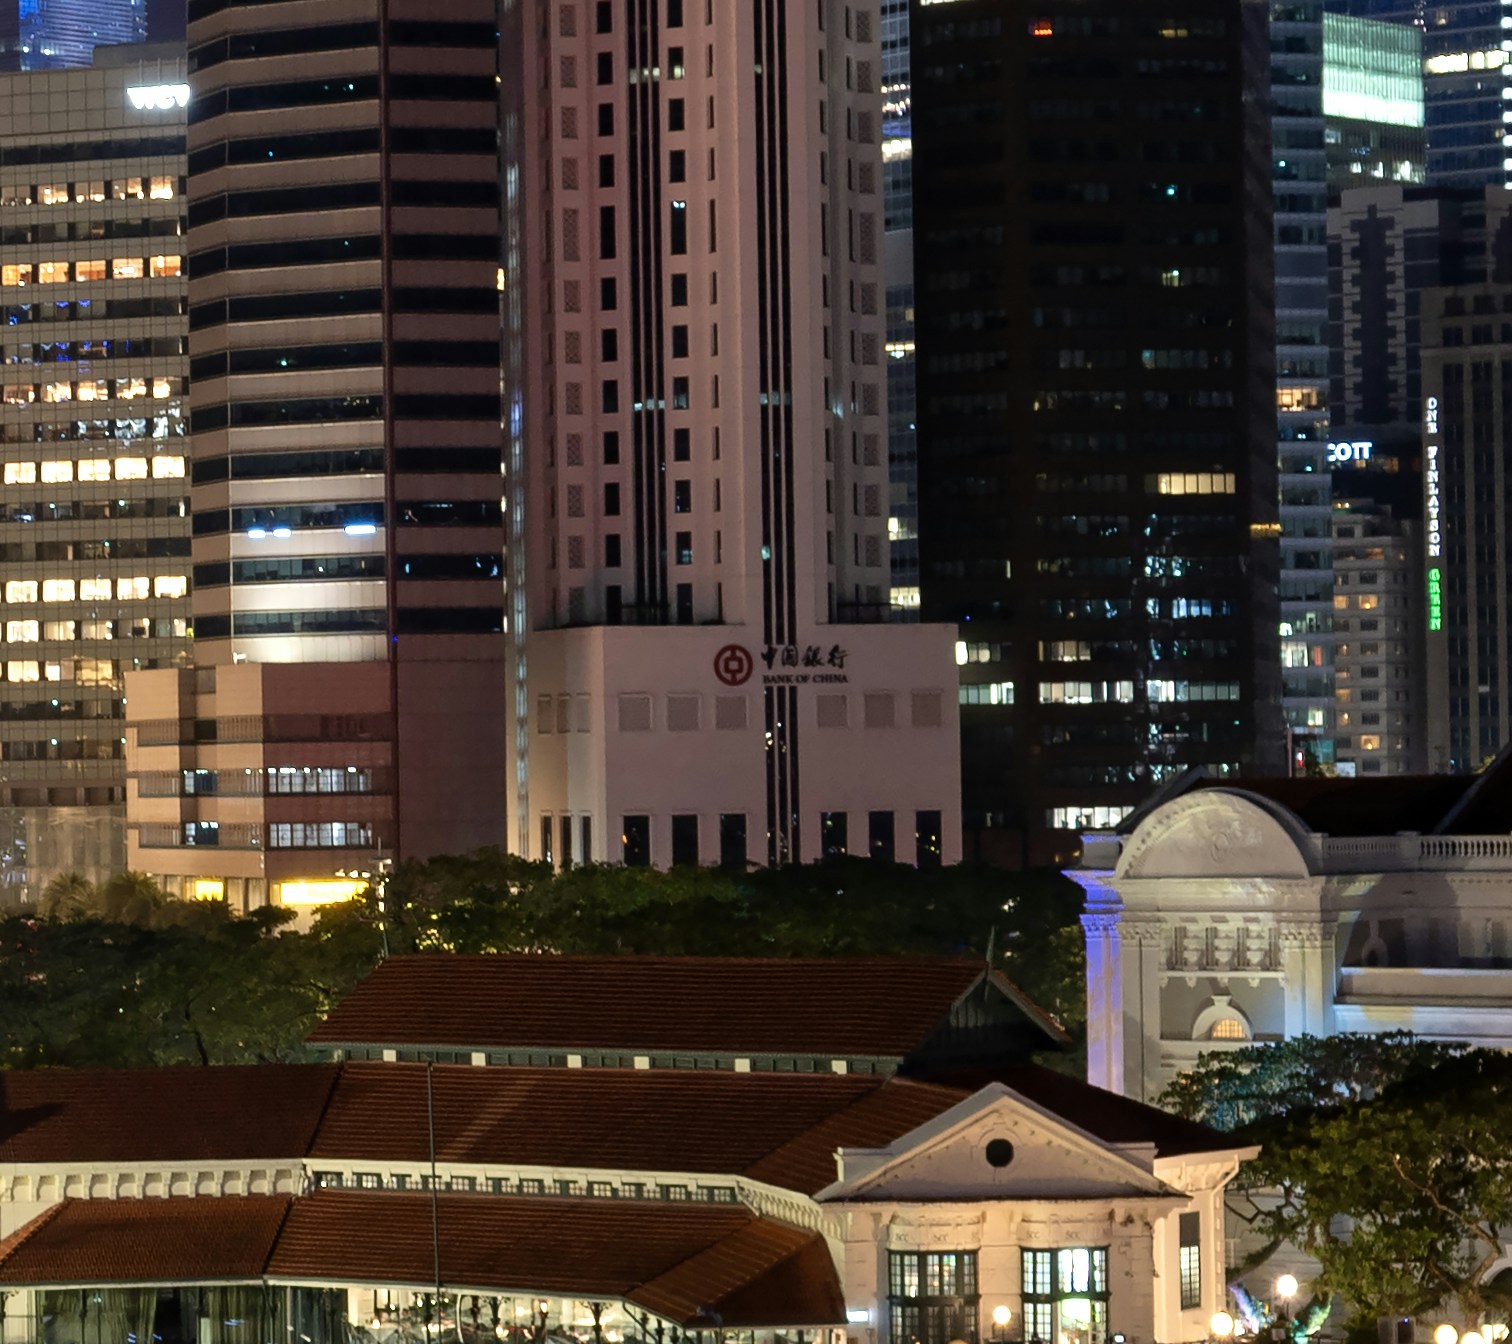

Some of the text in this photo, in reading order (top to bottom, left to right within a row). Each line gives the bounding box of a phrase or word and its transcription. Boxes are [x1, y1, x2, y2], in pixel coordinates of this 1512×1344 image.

[1427, 446, 1441, 557] FINLAYSON
[762, 674, 849, 684] BANK OF CHINA
